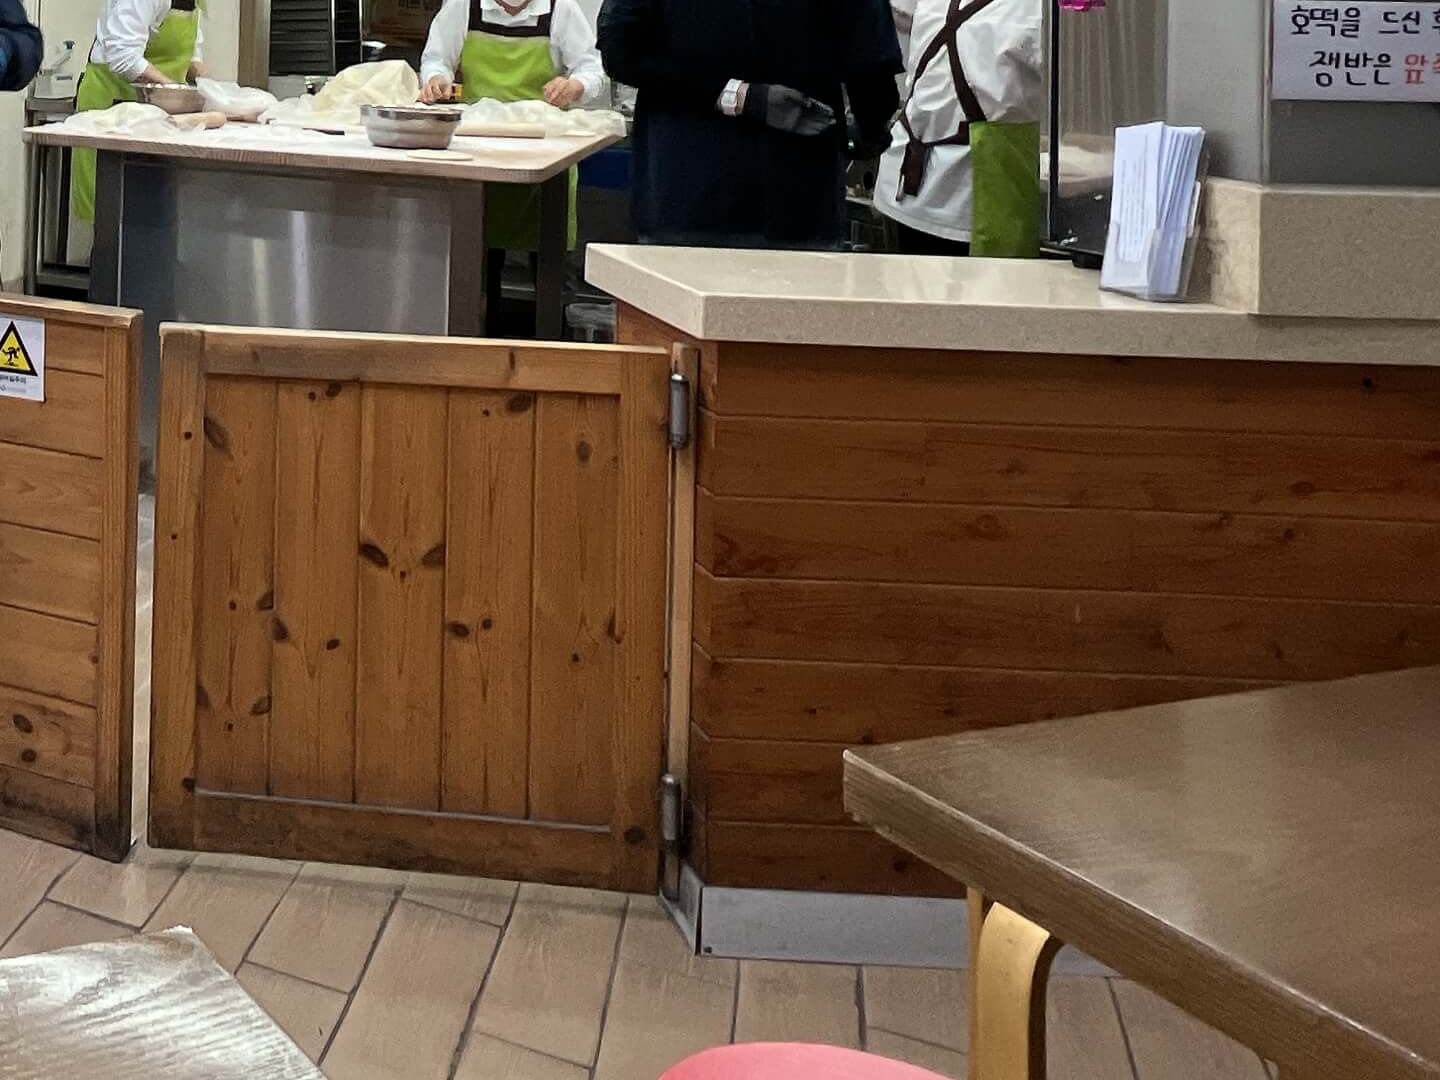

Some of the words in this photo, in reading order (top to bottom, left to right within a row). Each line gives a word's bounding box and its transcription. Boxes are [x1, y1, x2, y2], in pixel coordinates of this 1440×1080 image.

[1290, 4, 1361, 39] 호떡을
[1378, 10, 1422, 35] 드신
[1308, 50, 1392, 88] 쟁반은
